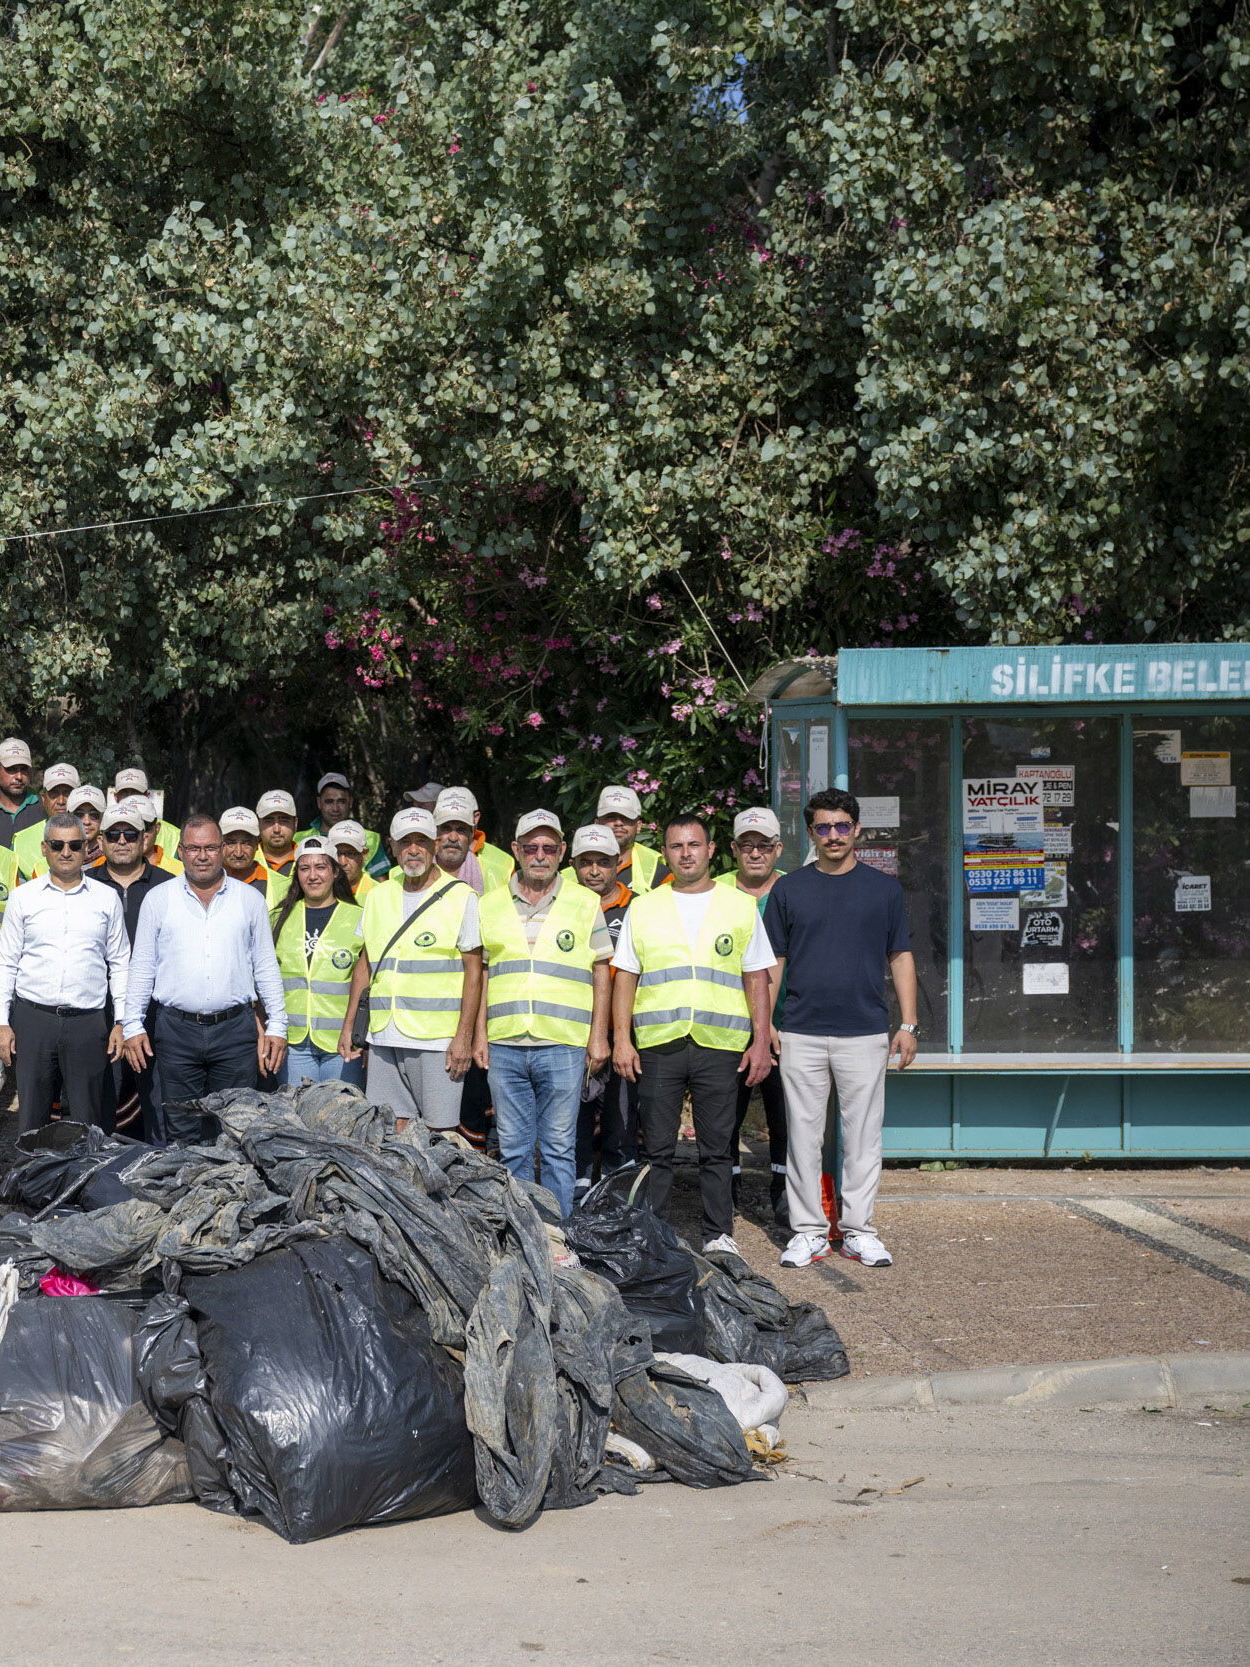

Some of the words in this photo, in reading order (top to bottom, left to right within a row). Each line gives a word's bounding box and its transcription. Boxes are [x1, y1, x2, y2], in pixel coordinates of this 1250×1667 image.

[991, 655, 1136, 696] SİLİFKE
[1149, 660, 1250, 692] BELE
[1018, 768, 1072, 779] KAPTANOĞLU
[967, 780, 1039, 796] MİRAY
[967, 796, 1040, 807] YATÇILIK
[1054, 792, 1061, 802] 17
[968, 870, 992, 878] 0530
[994, 869, 1012, 877] 732
[1013, 869, 1025, 877] 86
[1027, 868, 1037, 876] 11
[968, 878, 992, 886] 0533
[1013, 877, 1025, 885] 89
